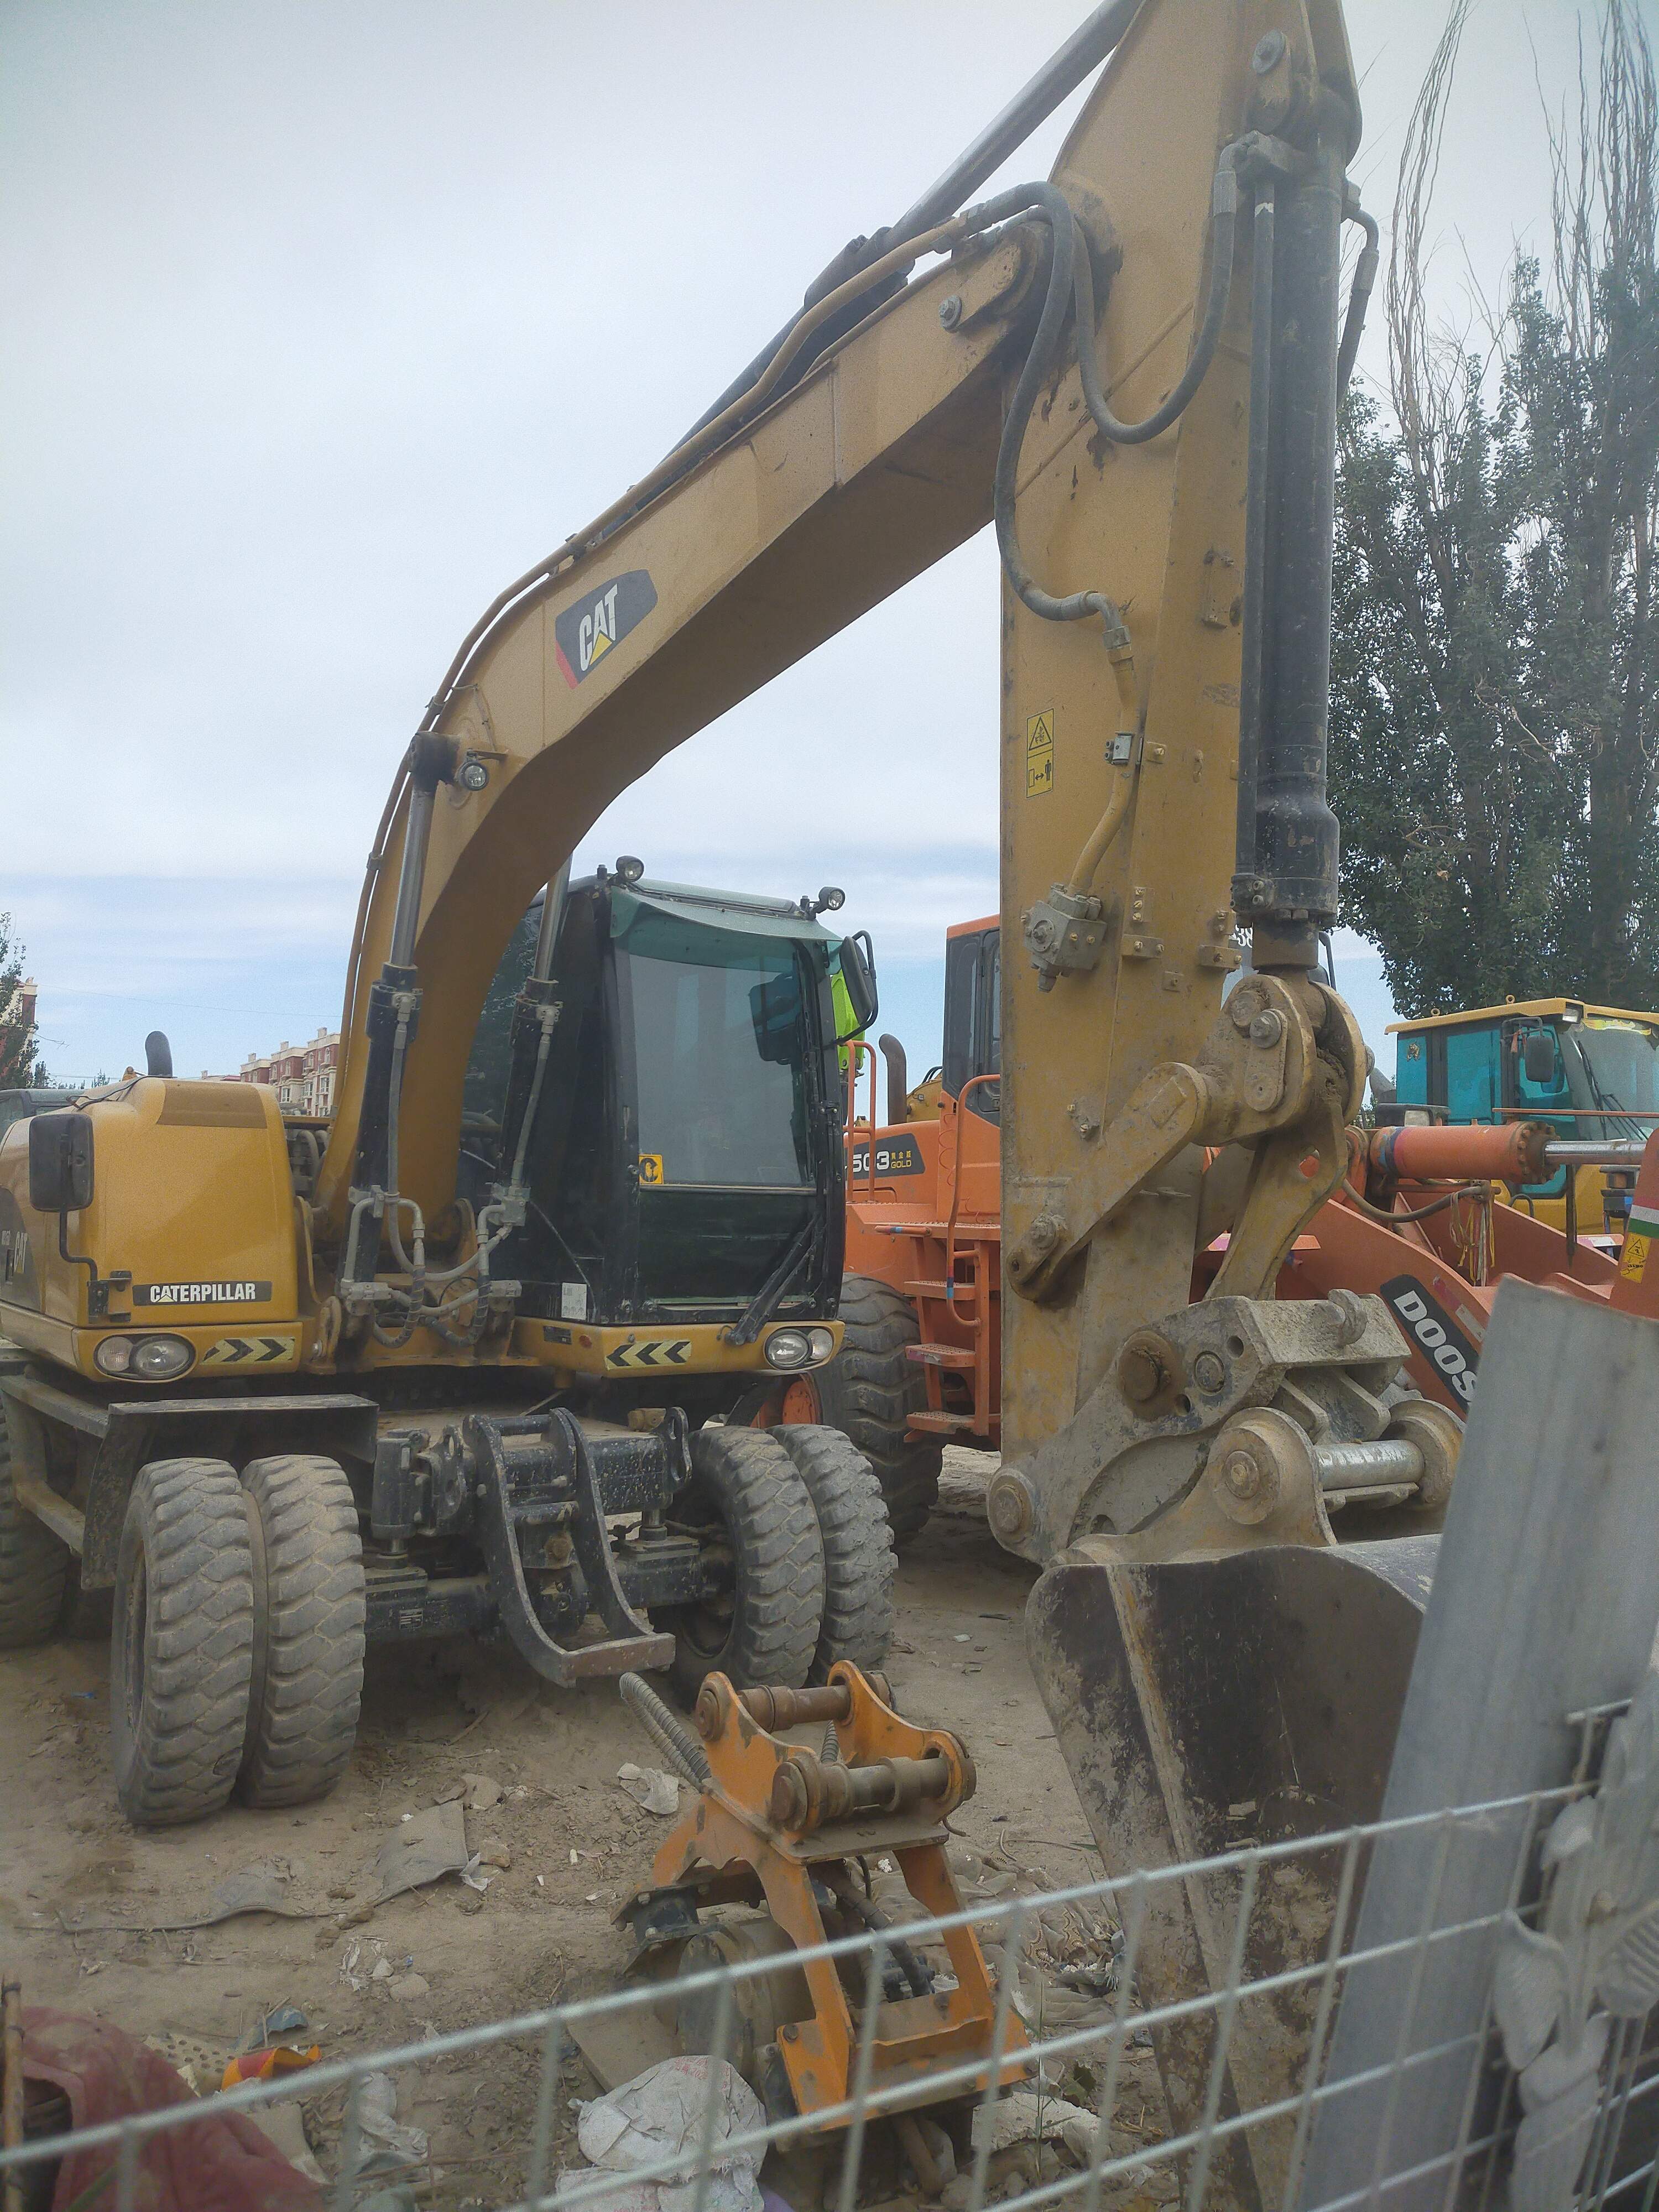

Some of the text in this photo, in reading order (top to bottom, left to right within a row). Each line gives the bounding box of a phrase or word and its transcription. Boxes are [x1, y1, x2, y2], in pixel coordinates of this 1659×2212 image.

[580, 583, 618, 671] CAT
[891, 1160, 911, 1168] GOLD
[14, 1231, 28, 1274] CAT
[150, 1283, 255, 1303] CATERPILLAR
[1394, 1290, 1478, 1405] DOOS
